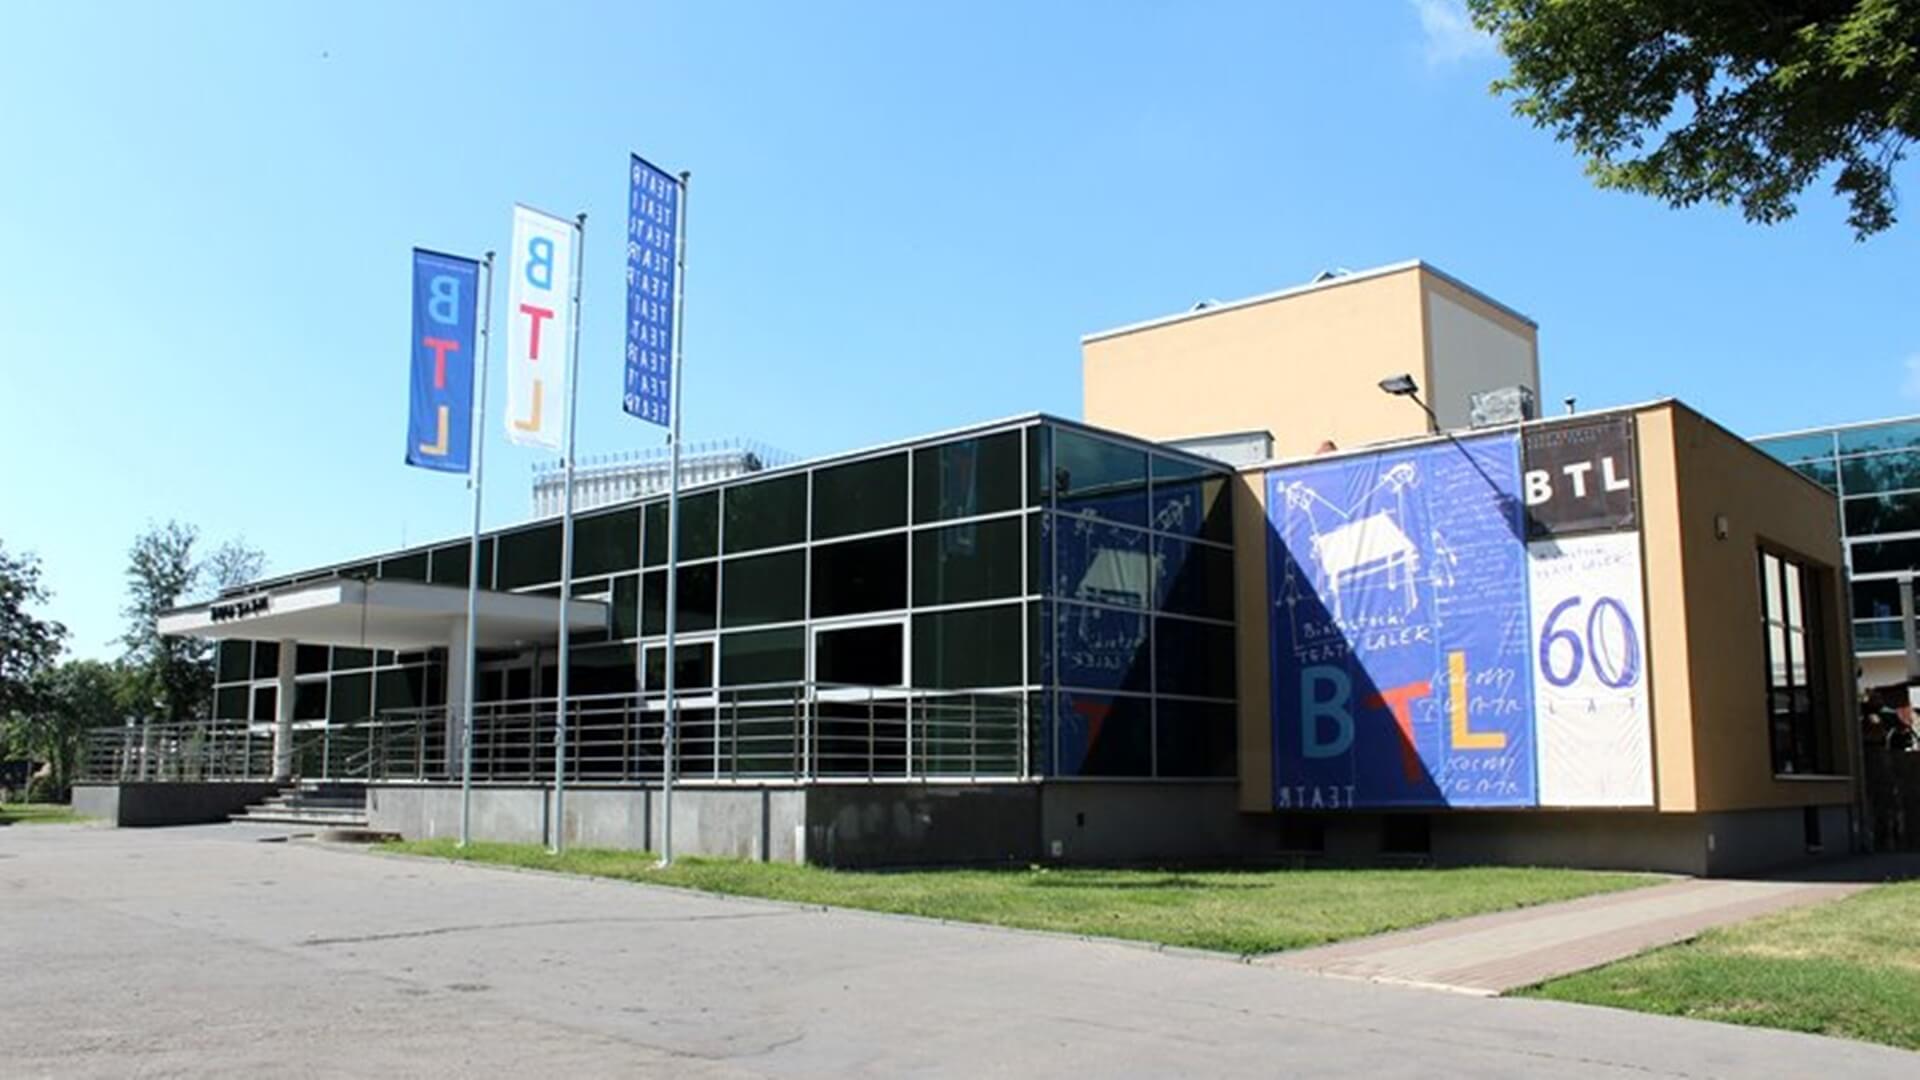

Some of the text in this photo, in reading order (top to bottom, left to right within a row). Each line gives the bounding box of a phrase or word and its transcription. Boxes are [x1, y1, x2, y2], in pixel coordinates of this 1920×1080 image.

[1525, 456, 1631, 507] BTL
[1539, 595, 1641, 689] 60
[1301, 650, 1508, 786] BTL
